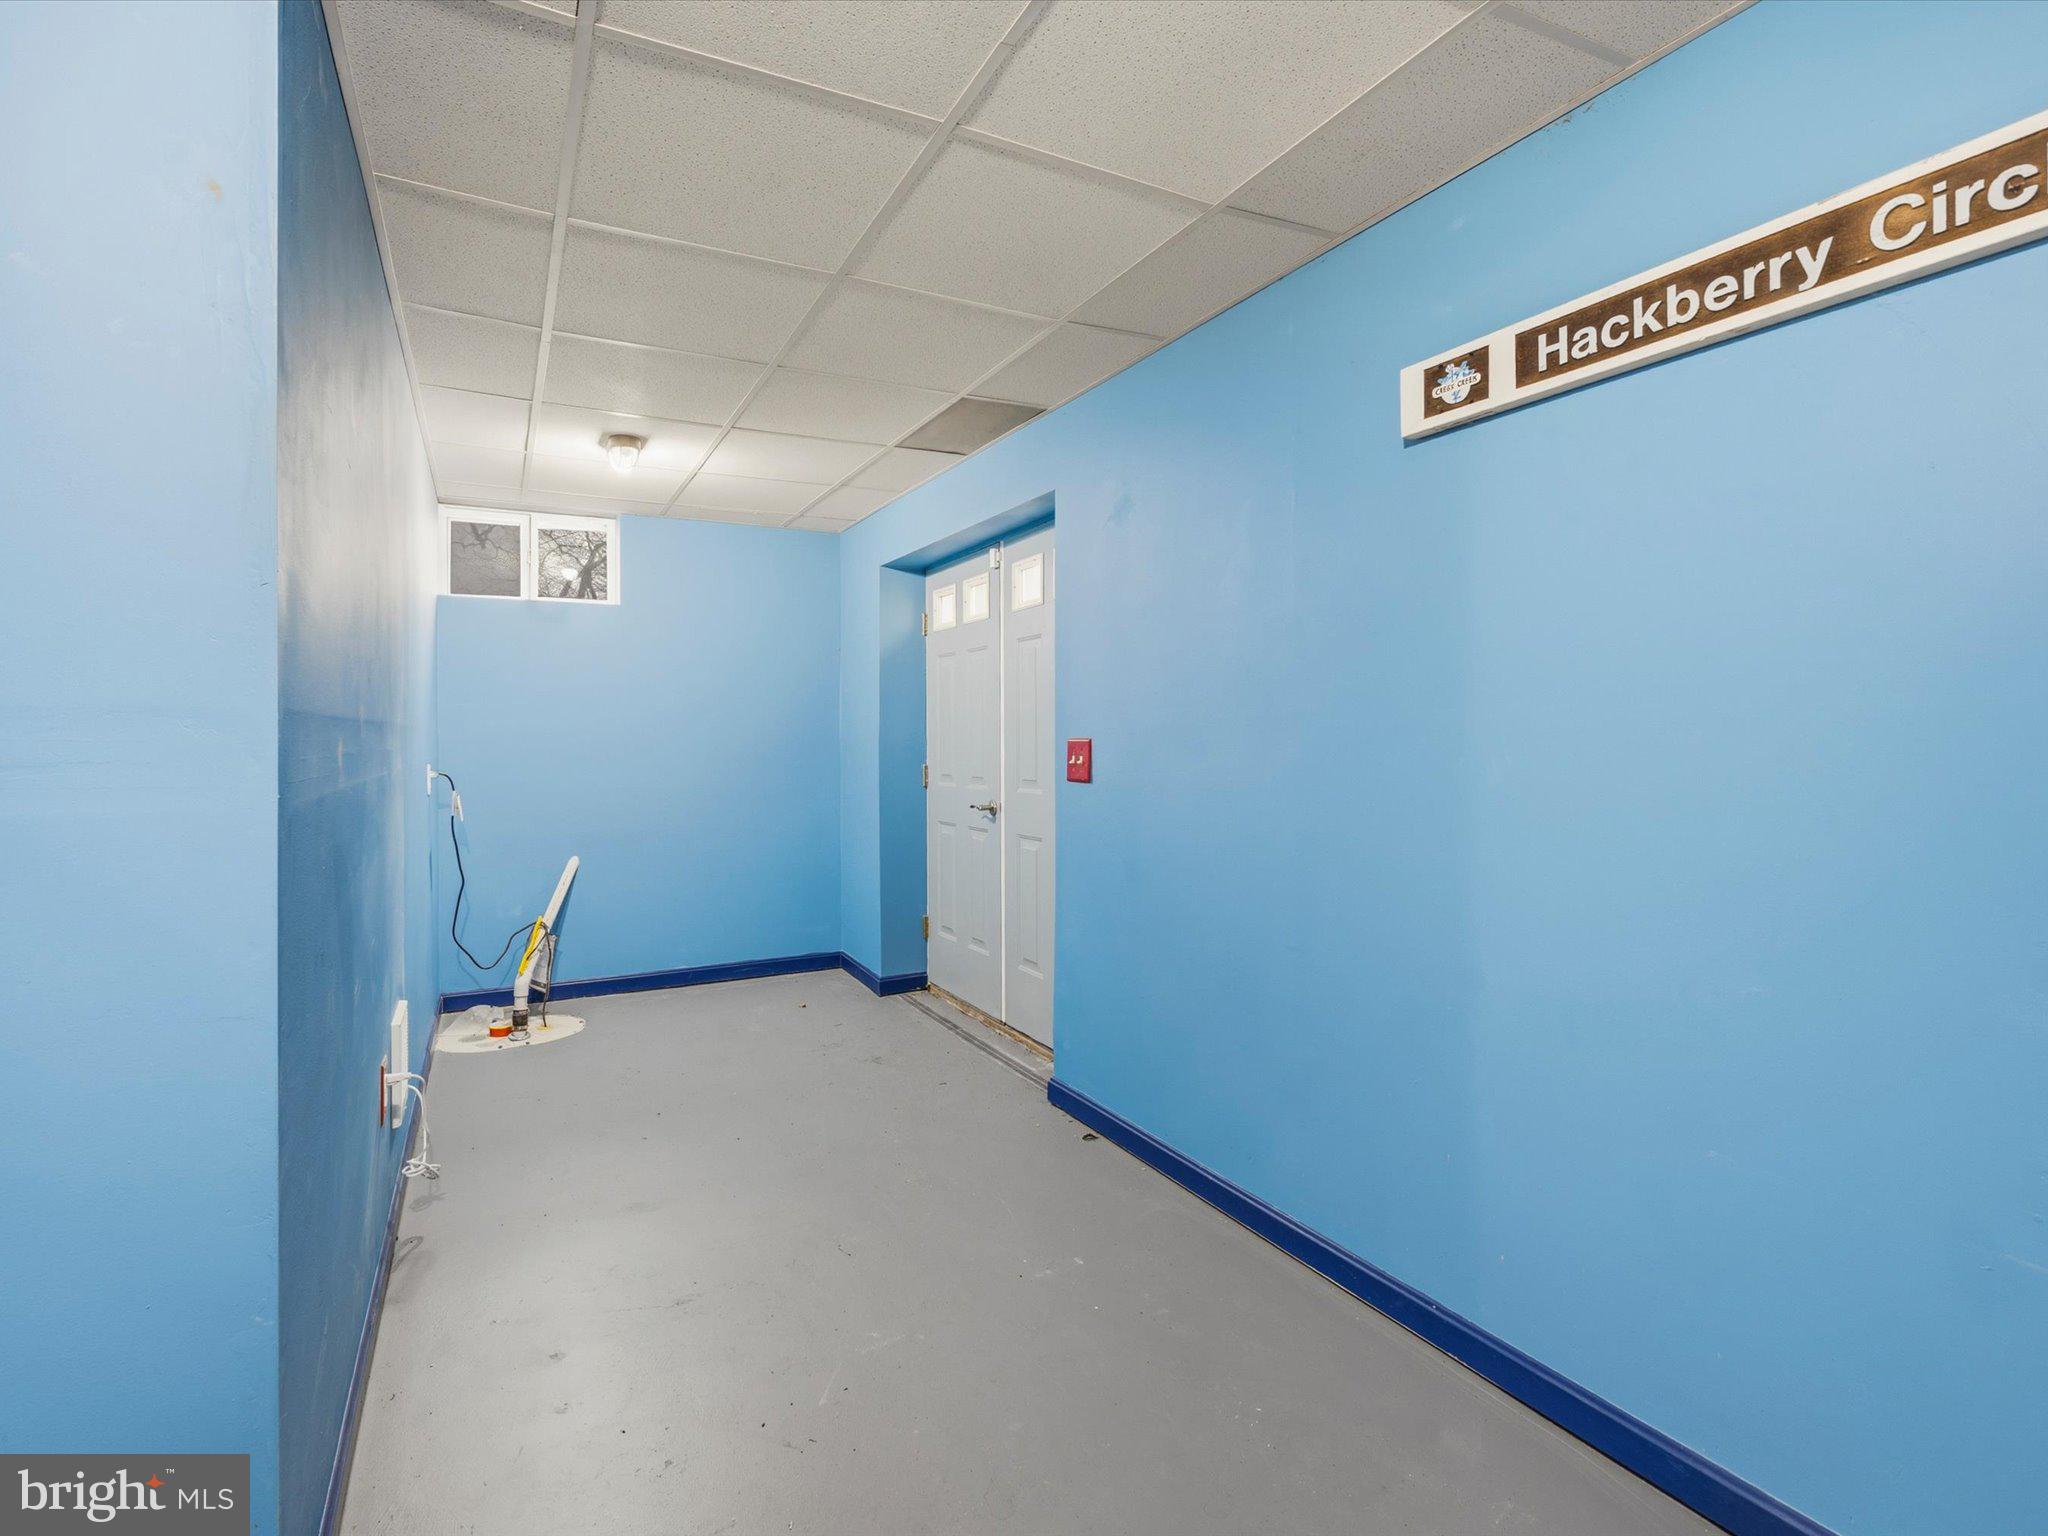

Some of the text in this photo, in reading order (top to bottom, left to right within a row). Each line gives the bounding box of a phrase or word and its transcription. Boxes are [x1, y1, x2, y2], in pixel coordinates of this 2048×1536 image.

[1537, 142, 2048, 372] Hackberry Circ
[1457, 375, 1478, 388] CREEK
